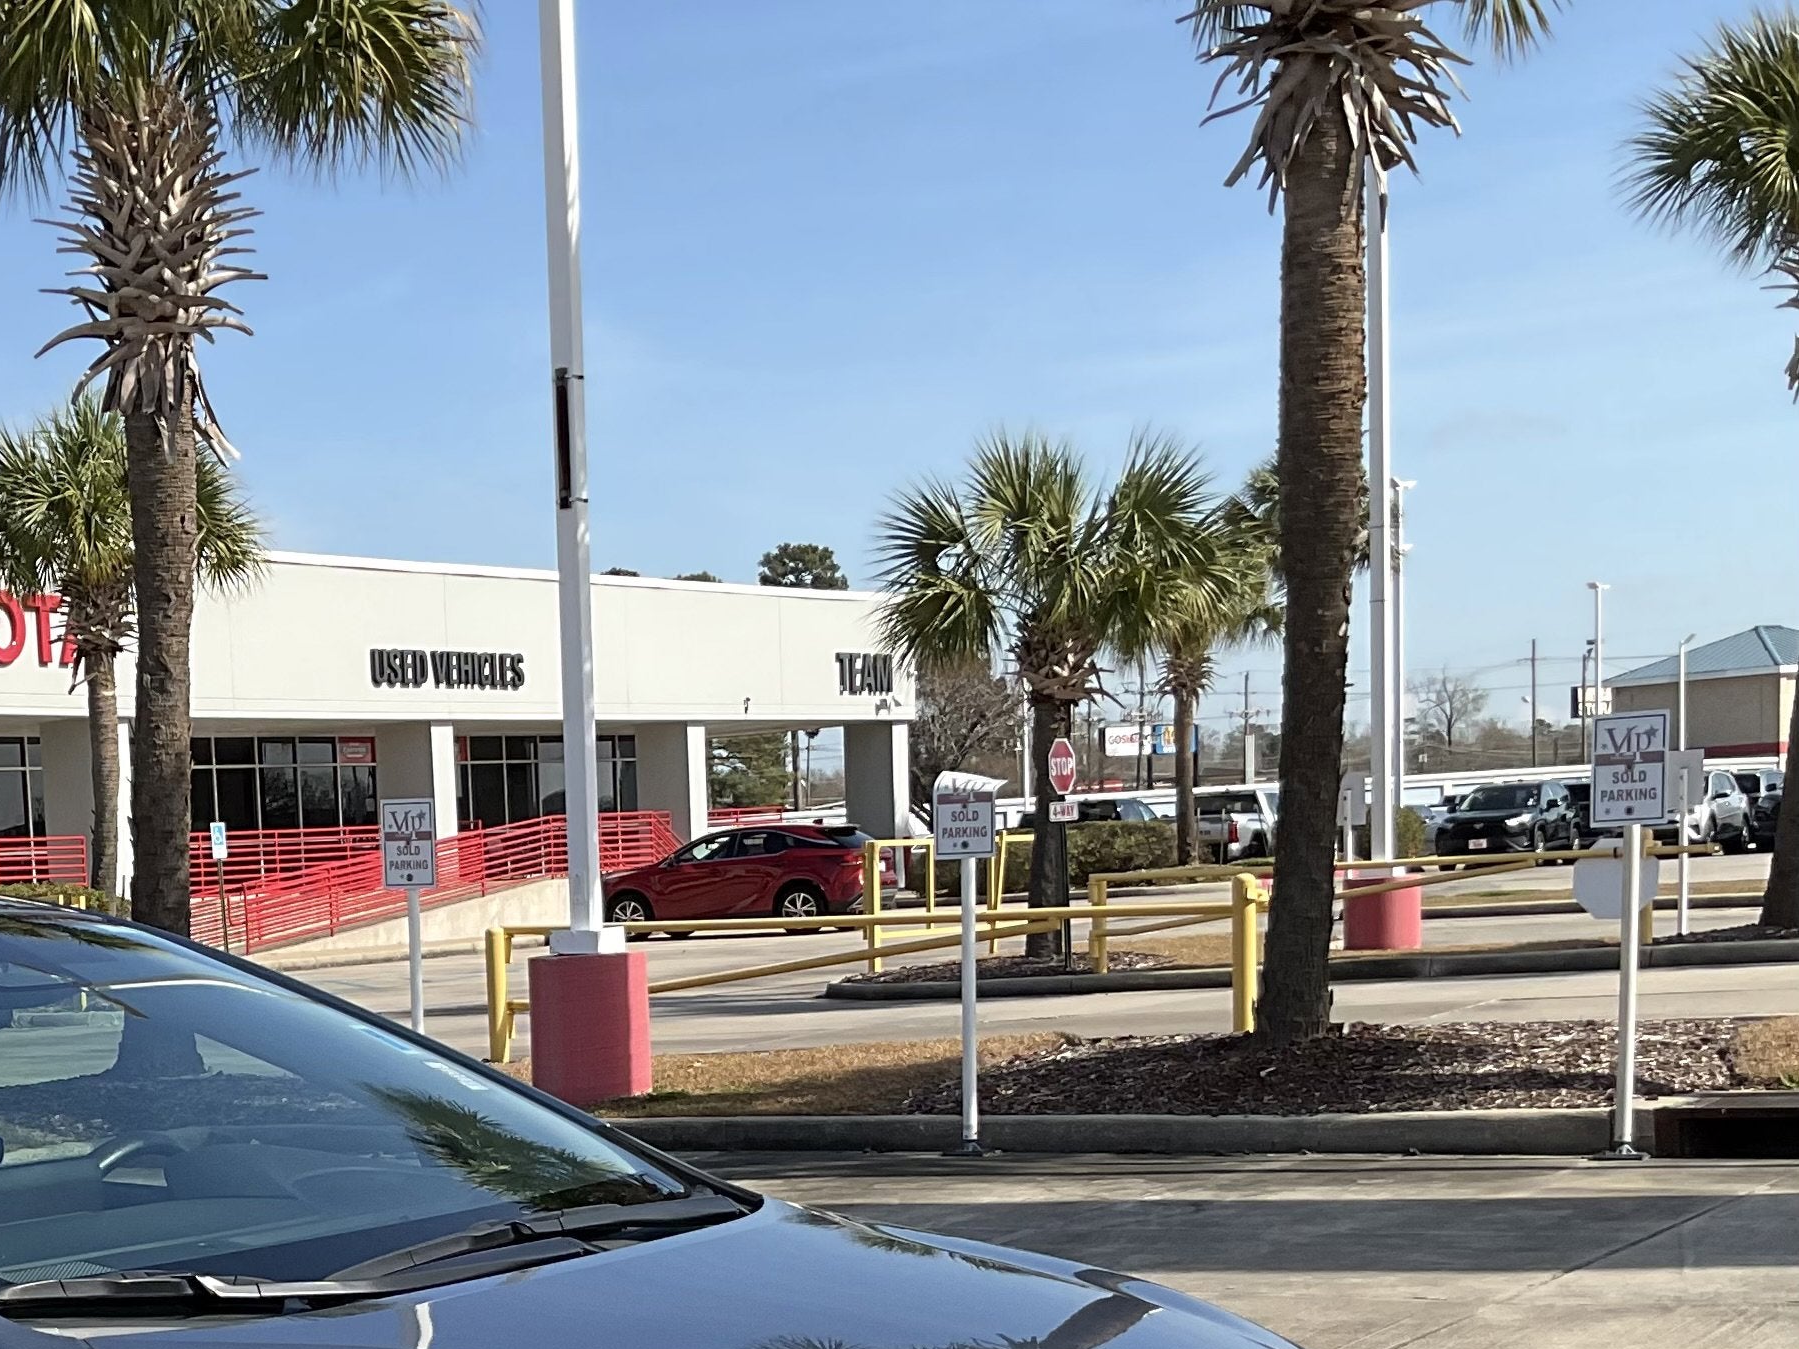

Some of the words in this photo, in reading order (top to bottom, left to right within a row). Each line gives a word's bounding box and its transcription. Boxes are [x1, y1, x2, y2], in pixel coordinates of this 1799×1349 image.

[370, 649, 428, 688] USED
[430, 651, 525, 691] VEHICLES
[835, 652, 893, 696] TEAM
[1051, 757, 1073, 776] STOP
[1612, 770, 1647, 784] SOLD
[1601, 787, 1657, 802] PARKING
[951, 810, 979, 822] SOLD
[942, 826, 988, 839] PARKING
[396, 846, 420, 856] SOLD
[389, 860, 428, 871] PARKING
